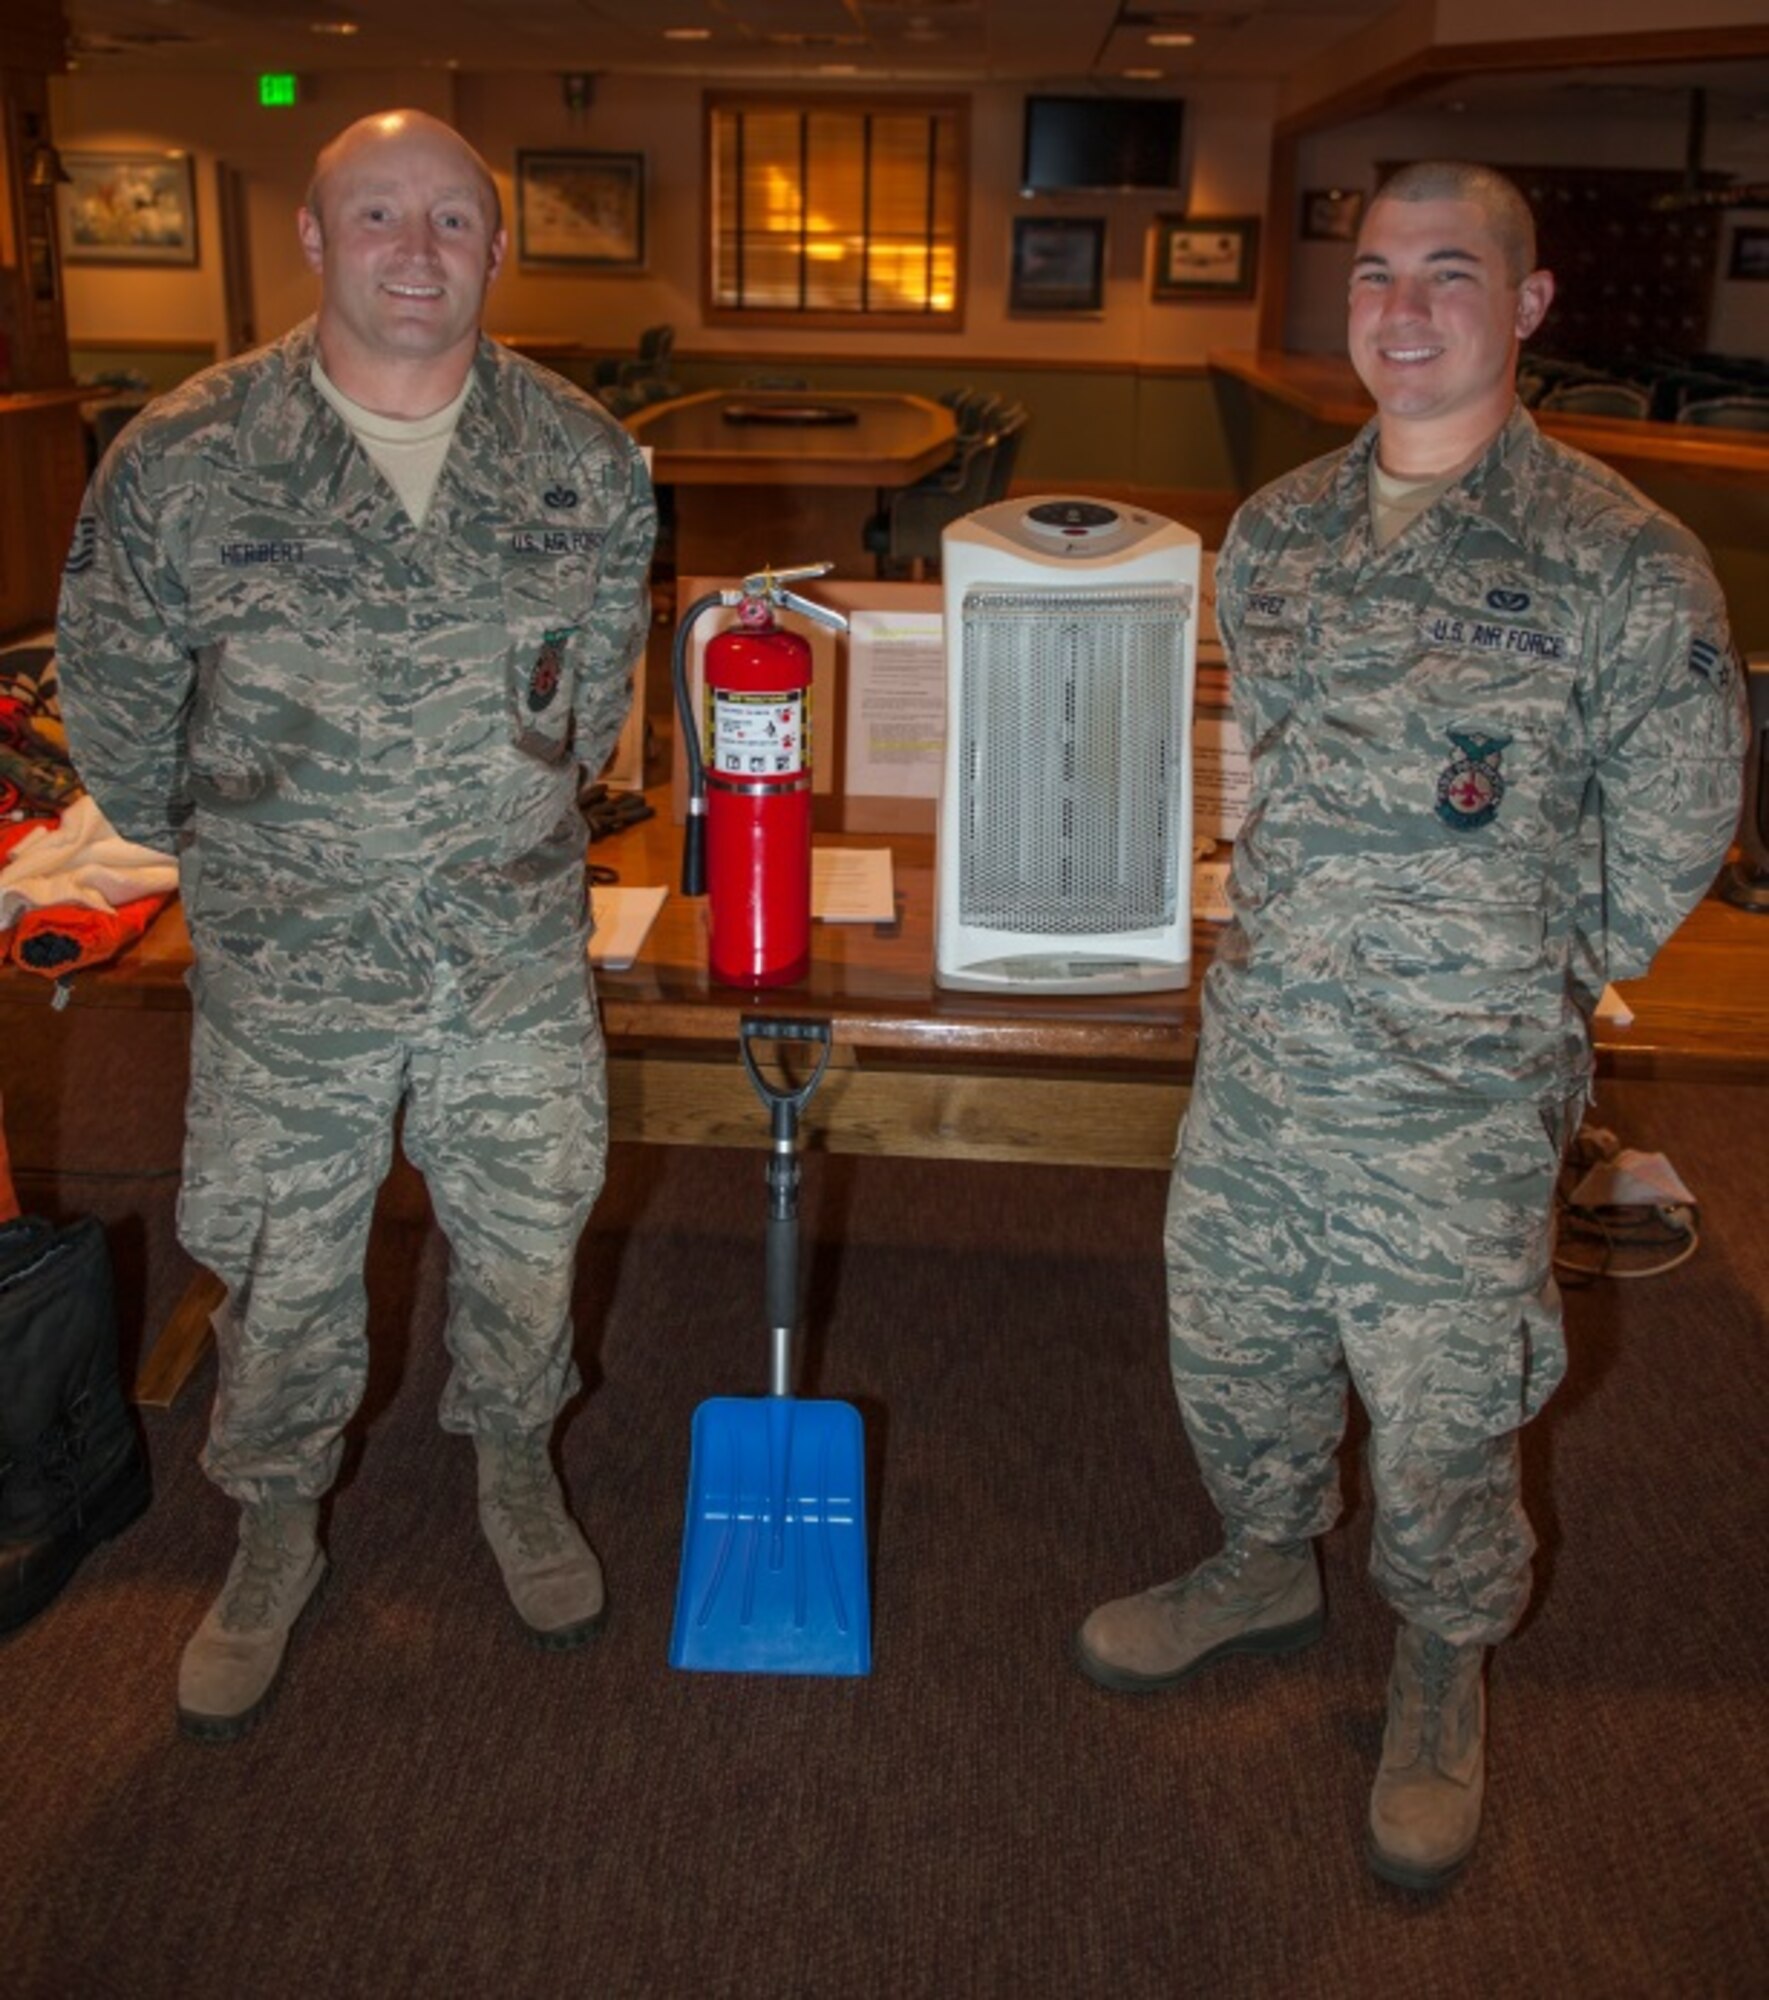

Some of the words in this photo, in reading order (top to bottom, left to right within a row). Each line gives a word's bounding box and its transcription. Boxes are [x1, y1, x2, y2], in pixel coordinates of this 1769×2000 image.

[220, 541, 304, 567] HERBERT
[1472, 624, 1503, 647] AIR
[1506, 629, 1567, 657] FORCE
